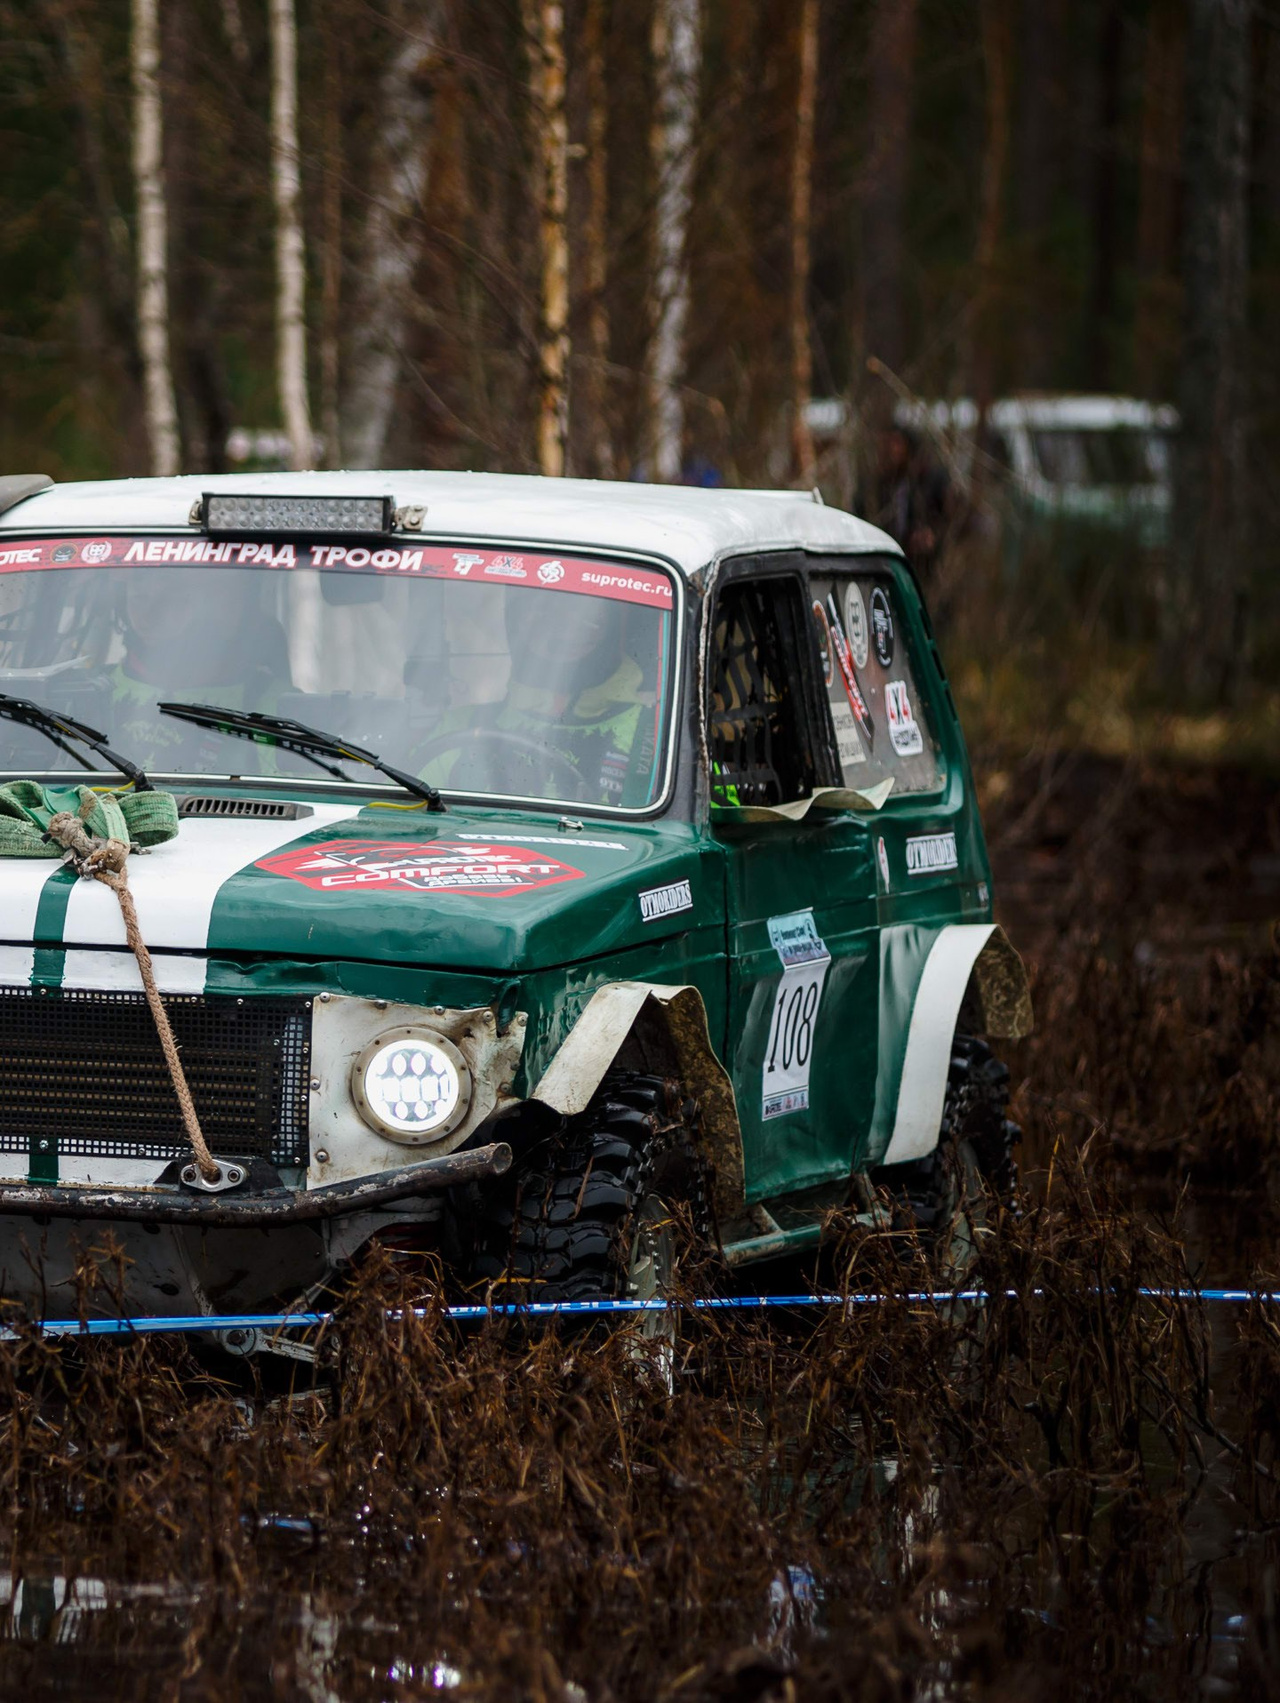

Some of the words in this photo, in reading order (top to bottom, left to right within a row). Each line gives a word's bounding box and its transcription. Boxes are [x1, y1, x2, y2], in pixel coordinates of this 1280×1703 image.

[123, 541, 297, 568] ЛЕНИНГРАД
[311, 545, 424, 571] ТРОФИ
[581, 571, 672, 597] suprotec.ru
[321, 864, 560, 887] COMFORT
[767, 981, 818, 1073] 108
